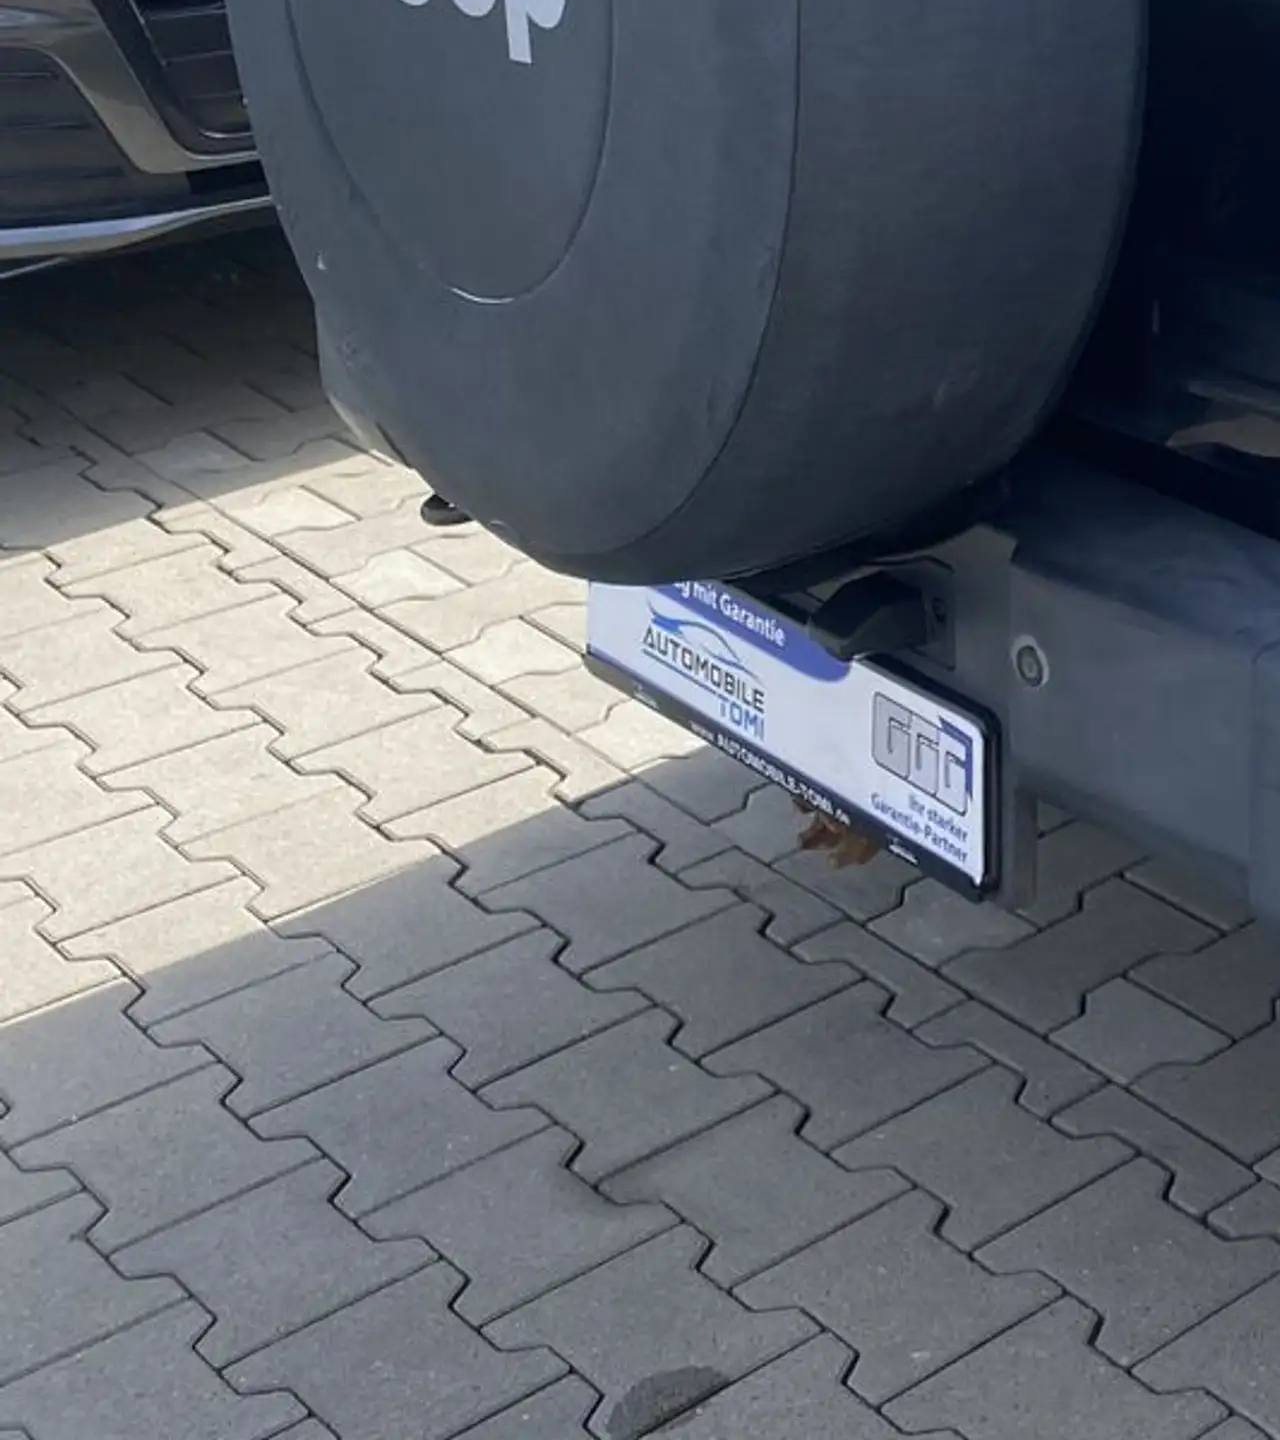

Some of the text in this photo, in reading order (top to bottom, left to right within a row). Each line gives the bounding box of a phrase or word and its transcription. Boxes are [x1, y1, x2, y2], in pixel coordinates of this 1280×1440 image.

[693, 581, 718, 610] mit
[719, 591, 786, 648] Garantie
[642, 625, 766, 714] AUTOMOBILE
[718, 694, 766, 742] TOMI
